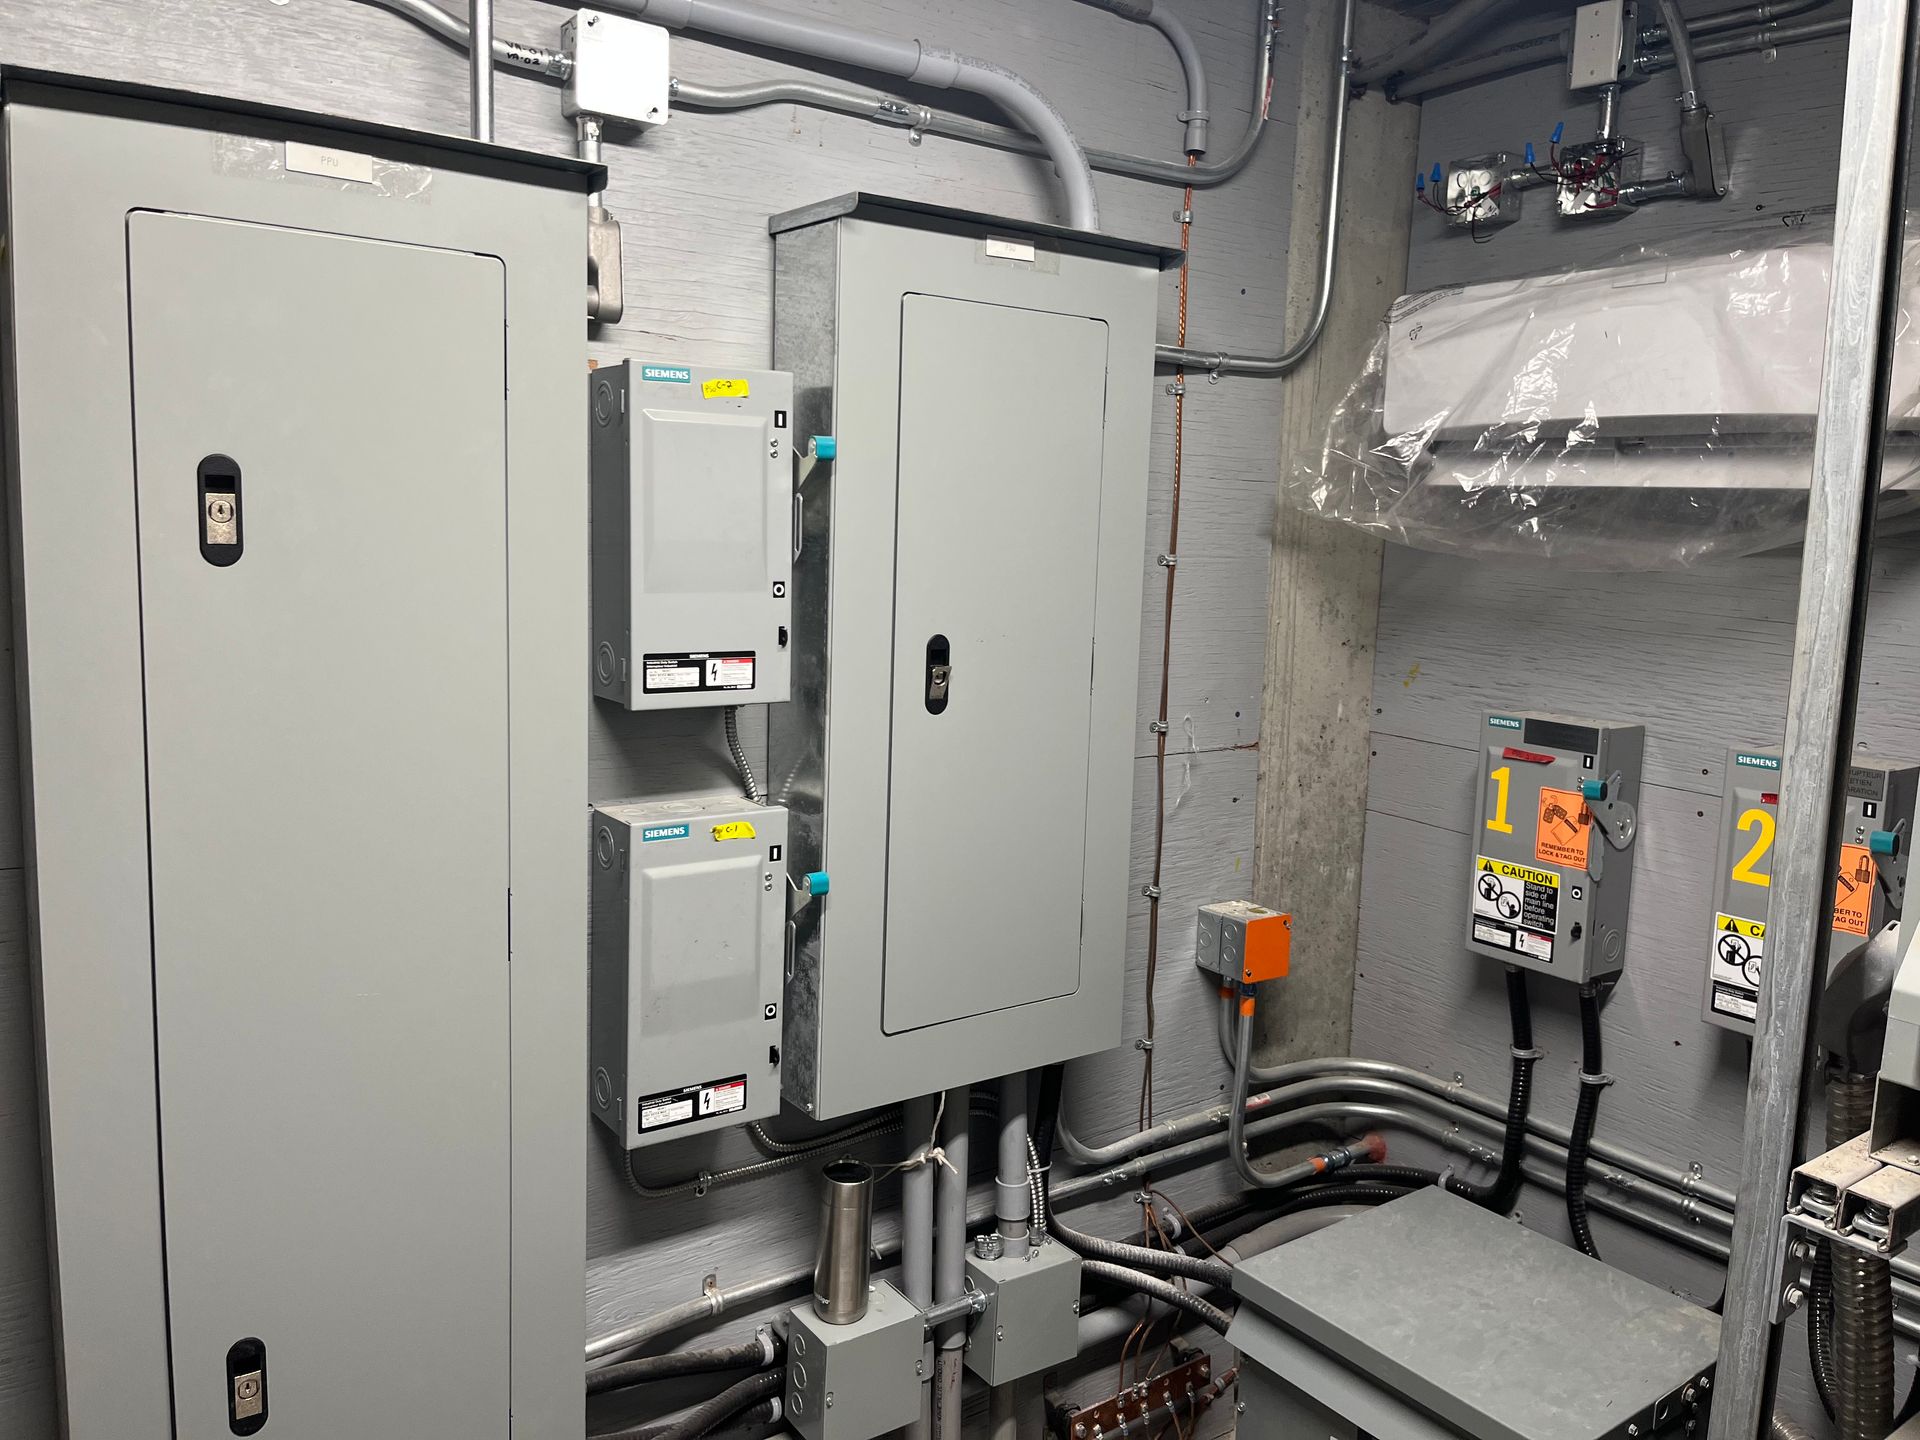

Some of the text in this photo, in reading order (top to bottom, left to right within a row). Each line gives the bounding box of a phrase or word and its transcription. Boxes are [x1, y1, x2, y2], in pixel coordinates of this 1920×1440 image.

[320, 156, 339, 167] PPU
[645, 368, 689, 380] SIEMENS
[1490, 717, 1520, 728] SIEMENS
[1738, 755, 1777, 768] SIEMENS
[1486, 766, 1513, 834] 1
[645, 827, 685, 838] SIEMENS
[1538, 849, 1554, 857] LOCK
[1541, 842, 1576, 854] REMEMBER
[1731, 808, 1776, 887] 2
[1502, 865, 1553, 885] CAUTION
[1525, 881, 1554, 895] Stand to
[1524, 890, 1539, 899] side
[1524, 897, 1555, 910] main line
[1525, 904, 1545, 914] before
[1524, 912, 1555, 925] operating
[1851, 910, 1863, 918] TO
[1848, 918, 1865, 927] OUT
